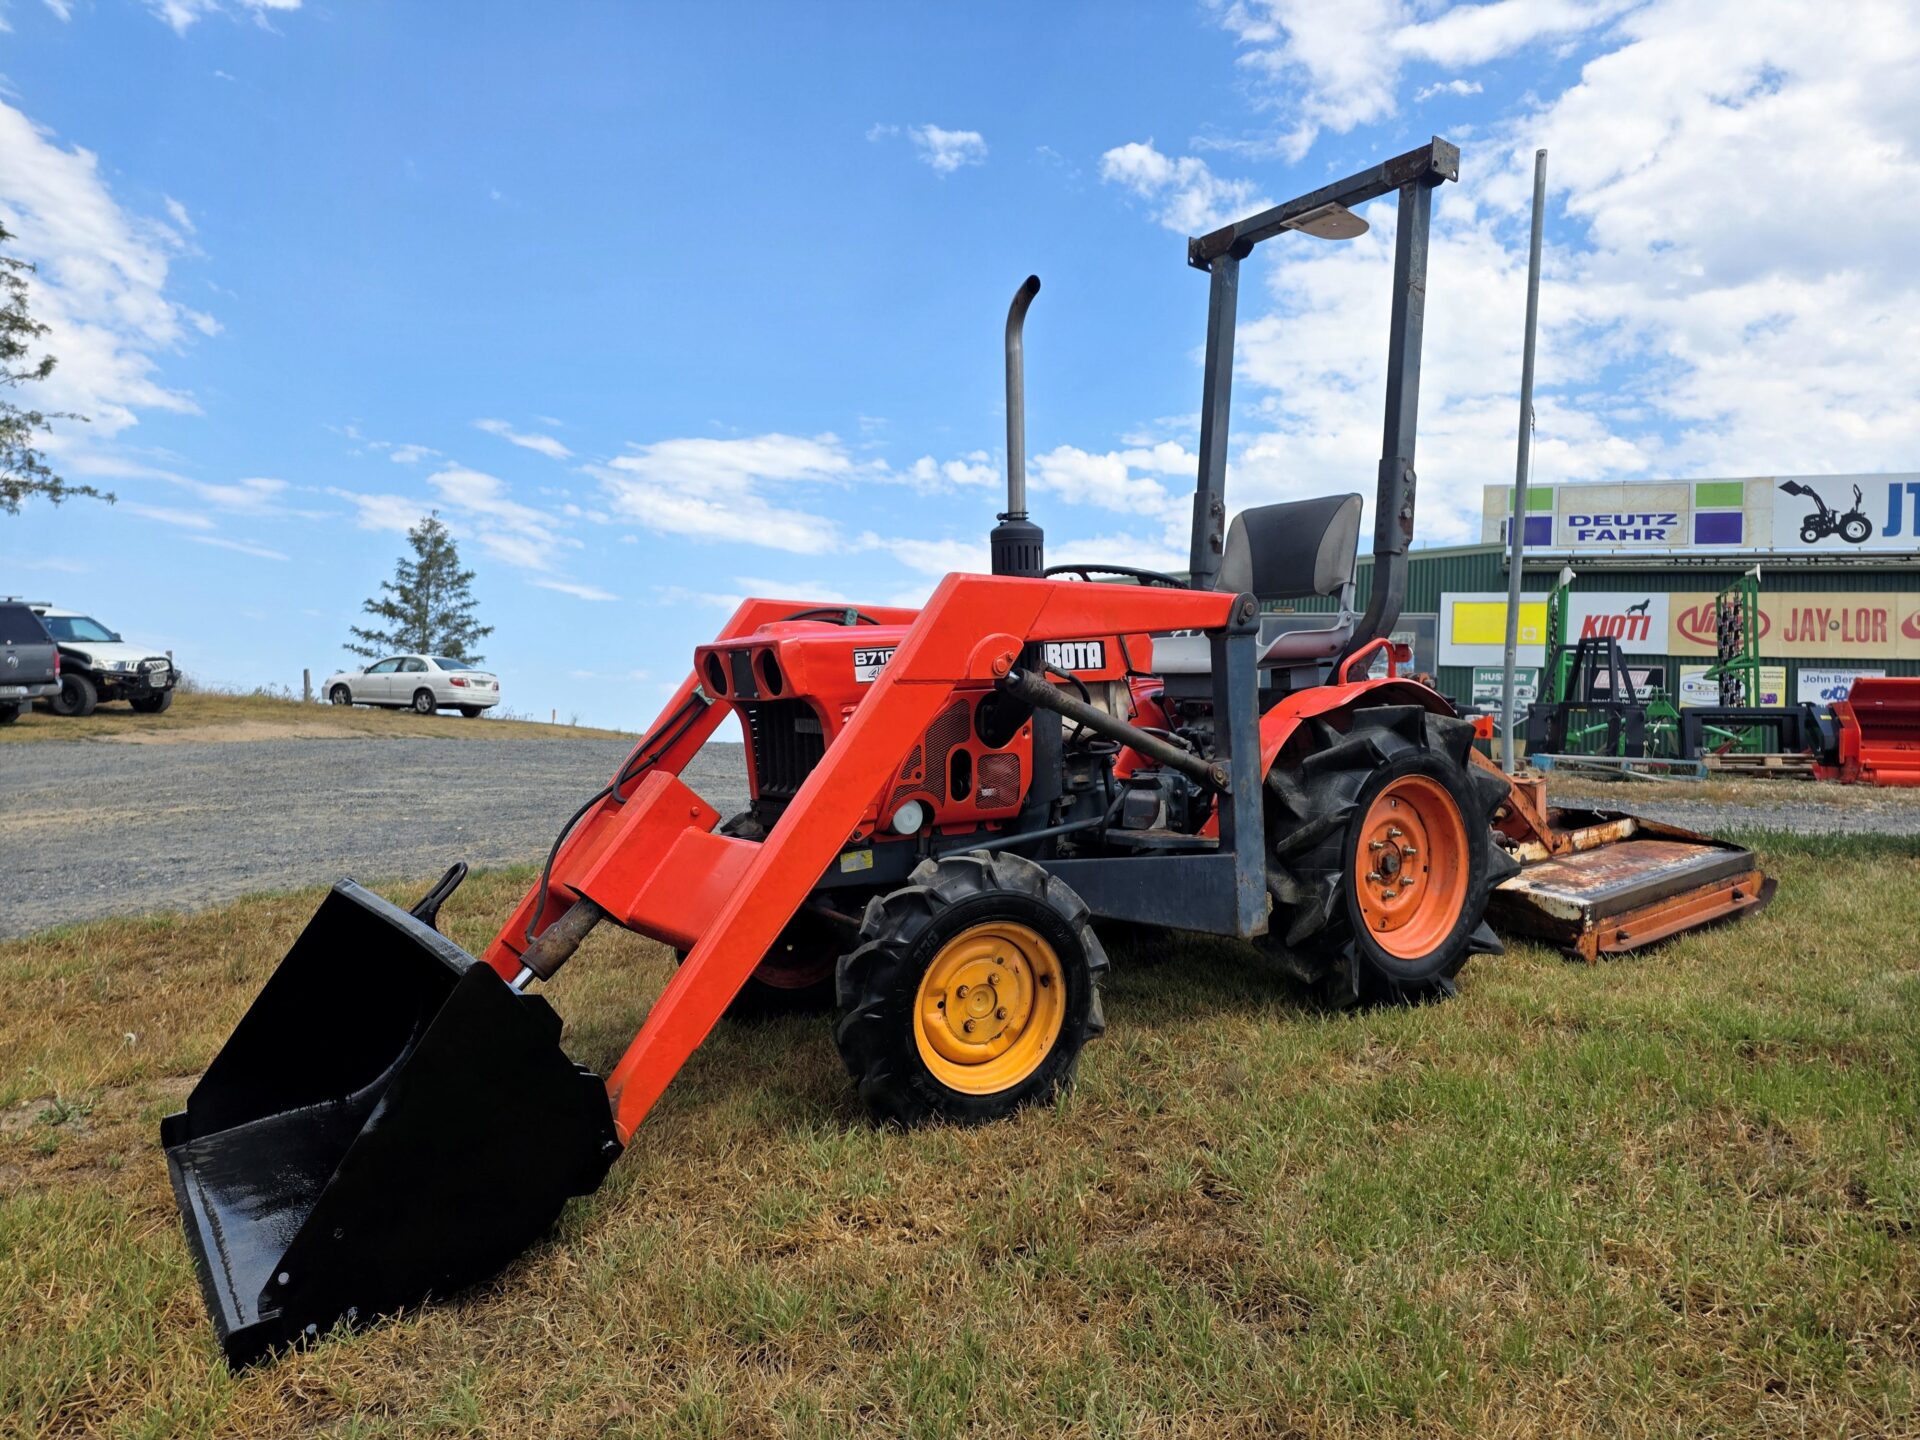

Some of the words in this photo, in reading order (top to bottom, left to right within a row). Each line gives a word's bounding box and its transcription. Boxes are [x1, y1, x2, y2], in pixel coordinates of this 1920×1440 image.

[1568, 513, 1678, 527] DEUTZ
[1577, 528, 1666, 541] FAHR
[1581, 614, 1652, 641] KIOTI
[1803, 675, 1829, 684] John
